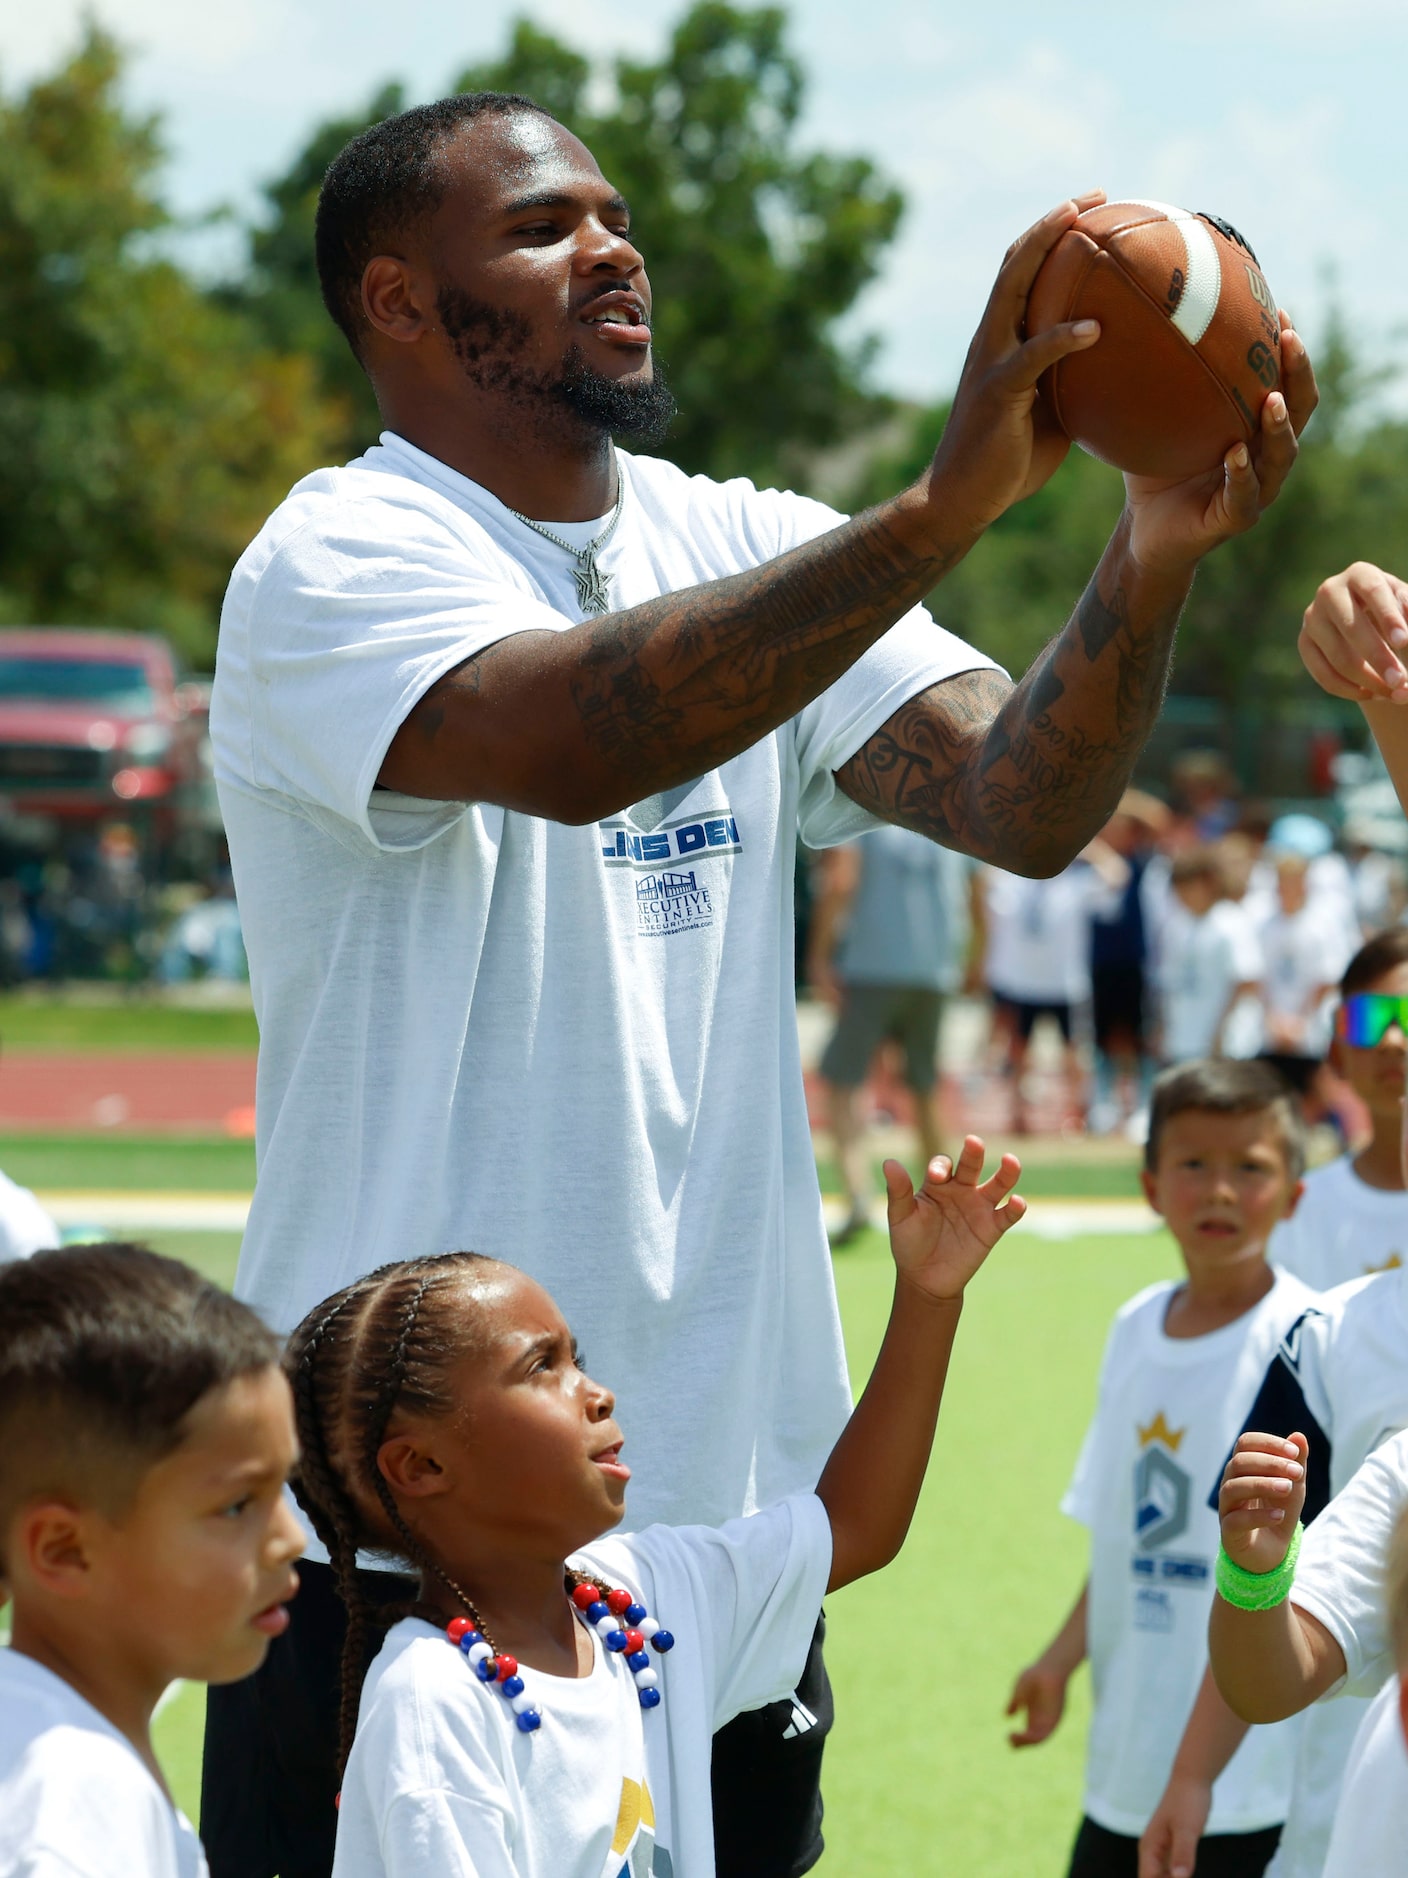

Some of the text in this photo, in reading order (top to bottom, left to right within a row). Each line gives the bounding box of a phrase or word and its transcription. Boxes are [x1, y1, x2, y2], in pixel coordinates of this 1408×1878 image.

[676, 818, 740, 854] DEN
[637, 890, 711, 915] XECUTIVE
[638, 903, 713, 925] ENTINELS
[646, 917, 692, 931] SECURITY
